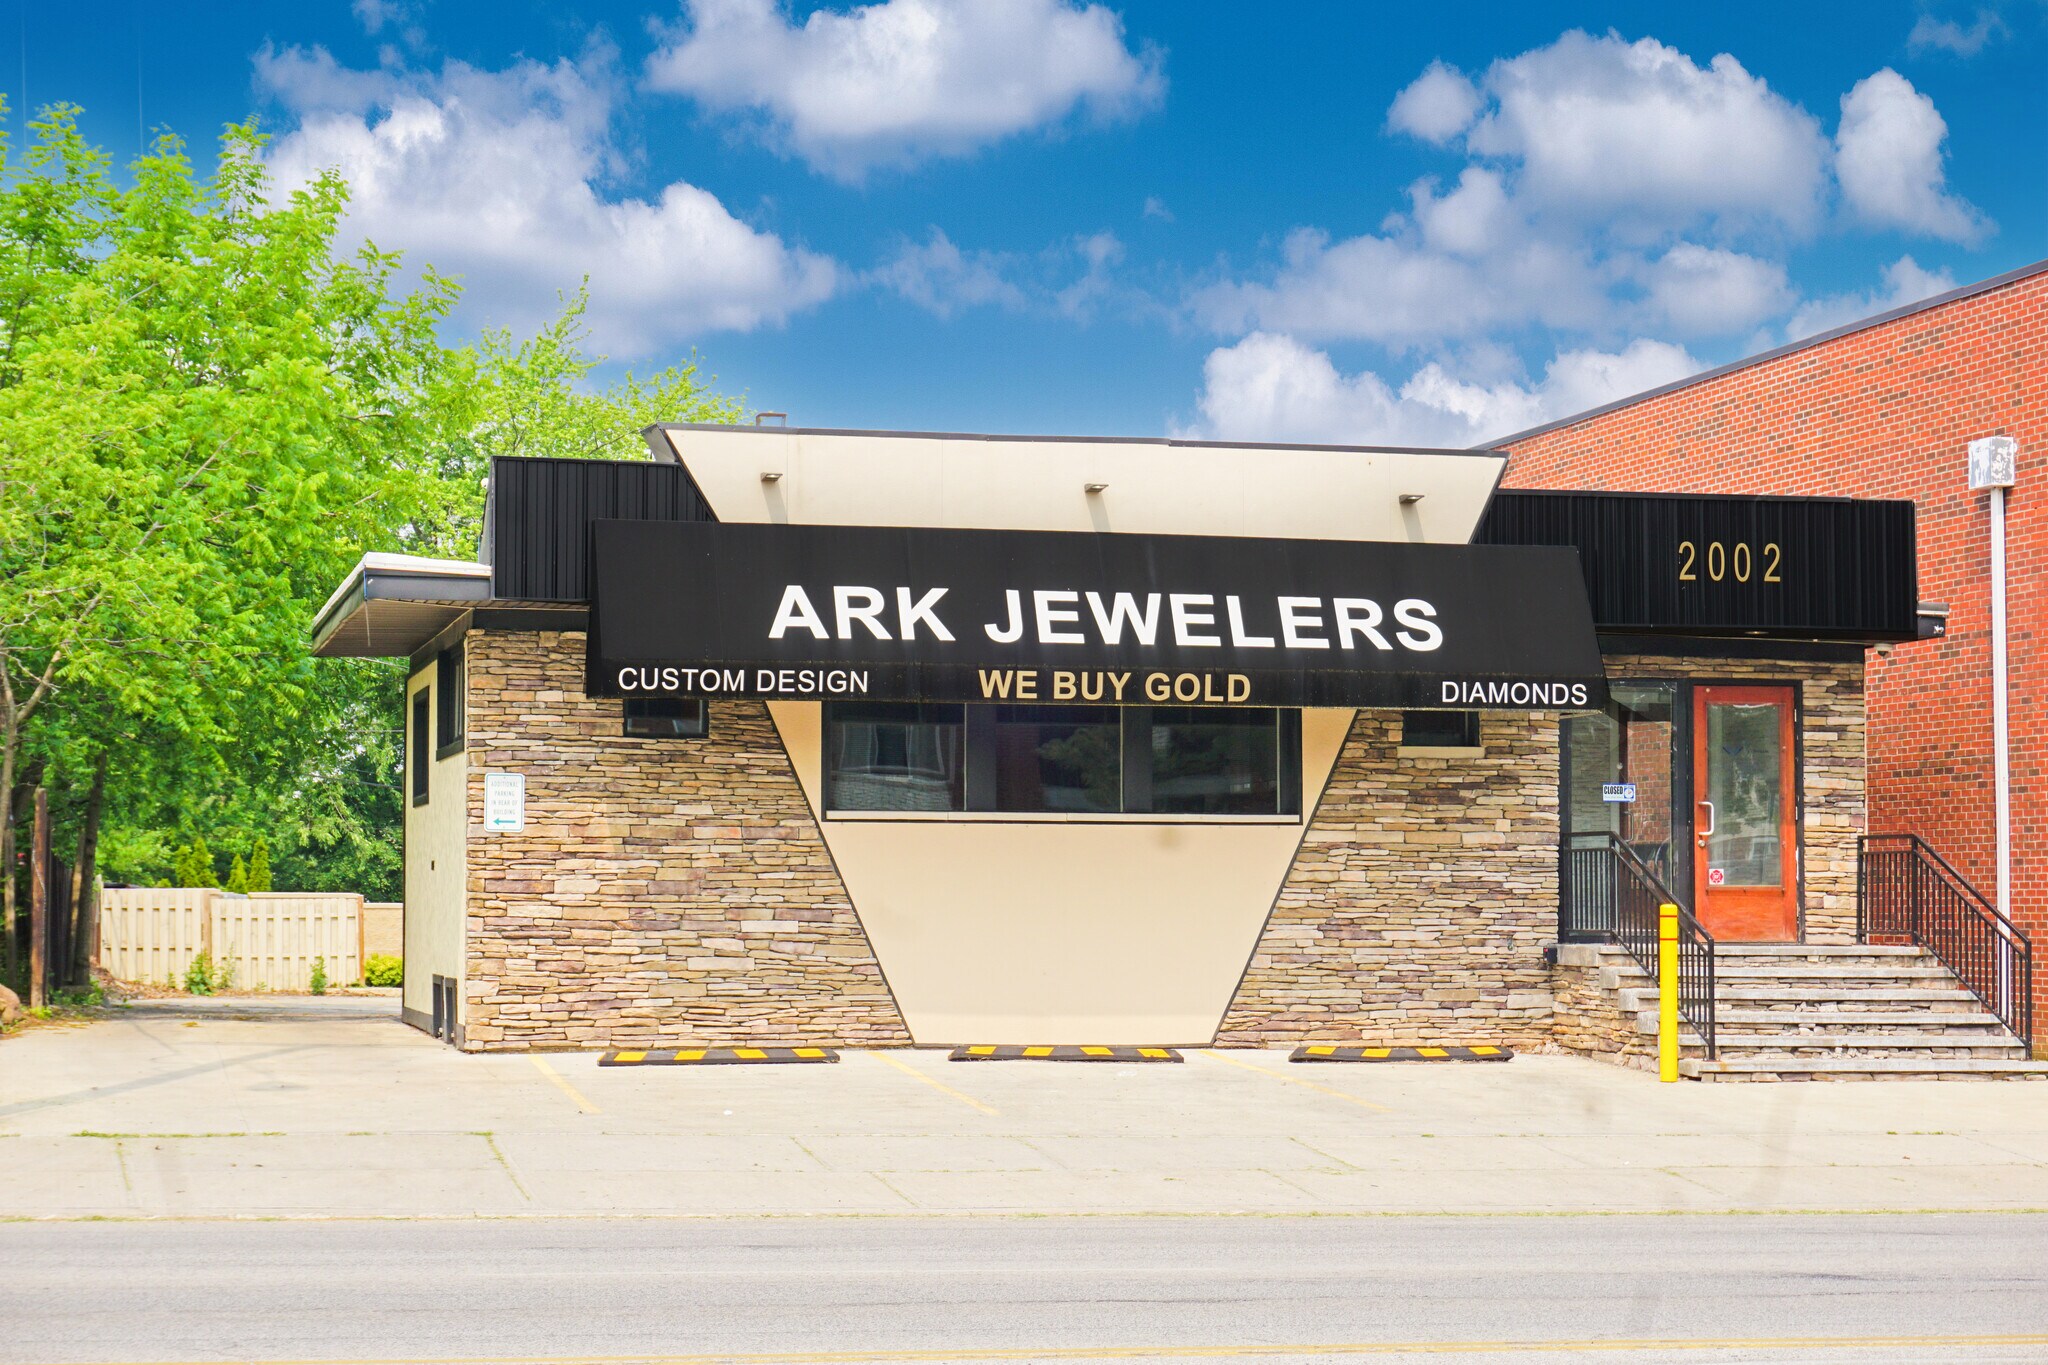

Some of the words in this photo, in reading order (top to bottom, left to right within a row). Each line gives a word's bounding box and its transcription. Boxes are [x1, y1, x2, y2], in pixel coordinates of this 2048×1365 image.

[1678, 541, 1781, 582] 2002
[767, 584, 957, 642] ARK
[983, 588, 1444, 653] JEWELERS
[618, 667, 746, 692] CUSTOM
[756, 669, 869, 694] DESIGN
[978, 669, 1038, 700] WE
[1053, 670, 1132, 702] BUY
[1144, 672, 1251, 704] GOLD
[1441, 680, 1588, 706] DIAMONDS
[1604, 786, 1624, 794] CLOSED
